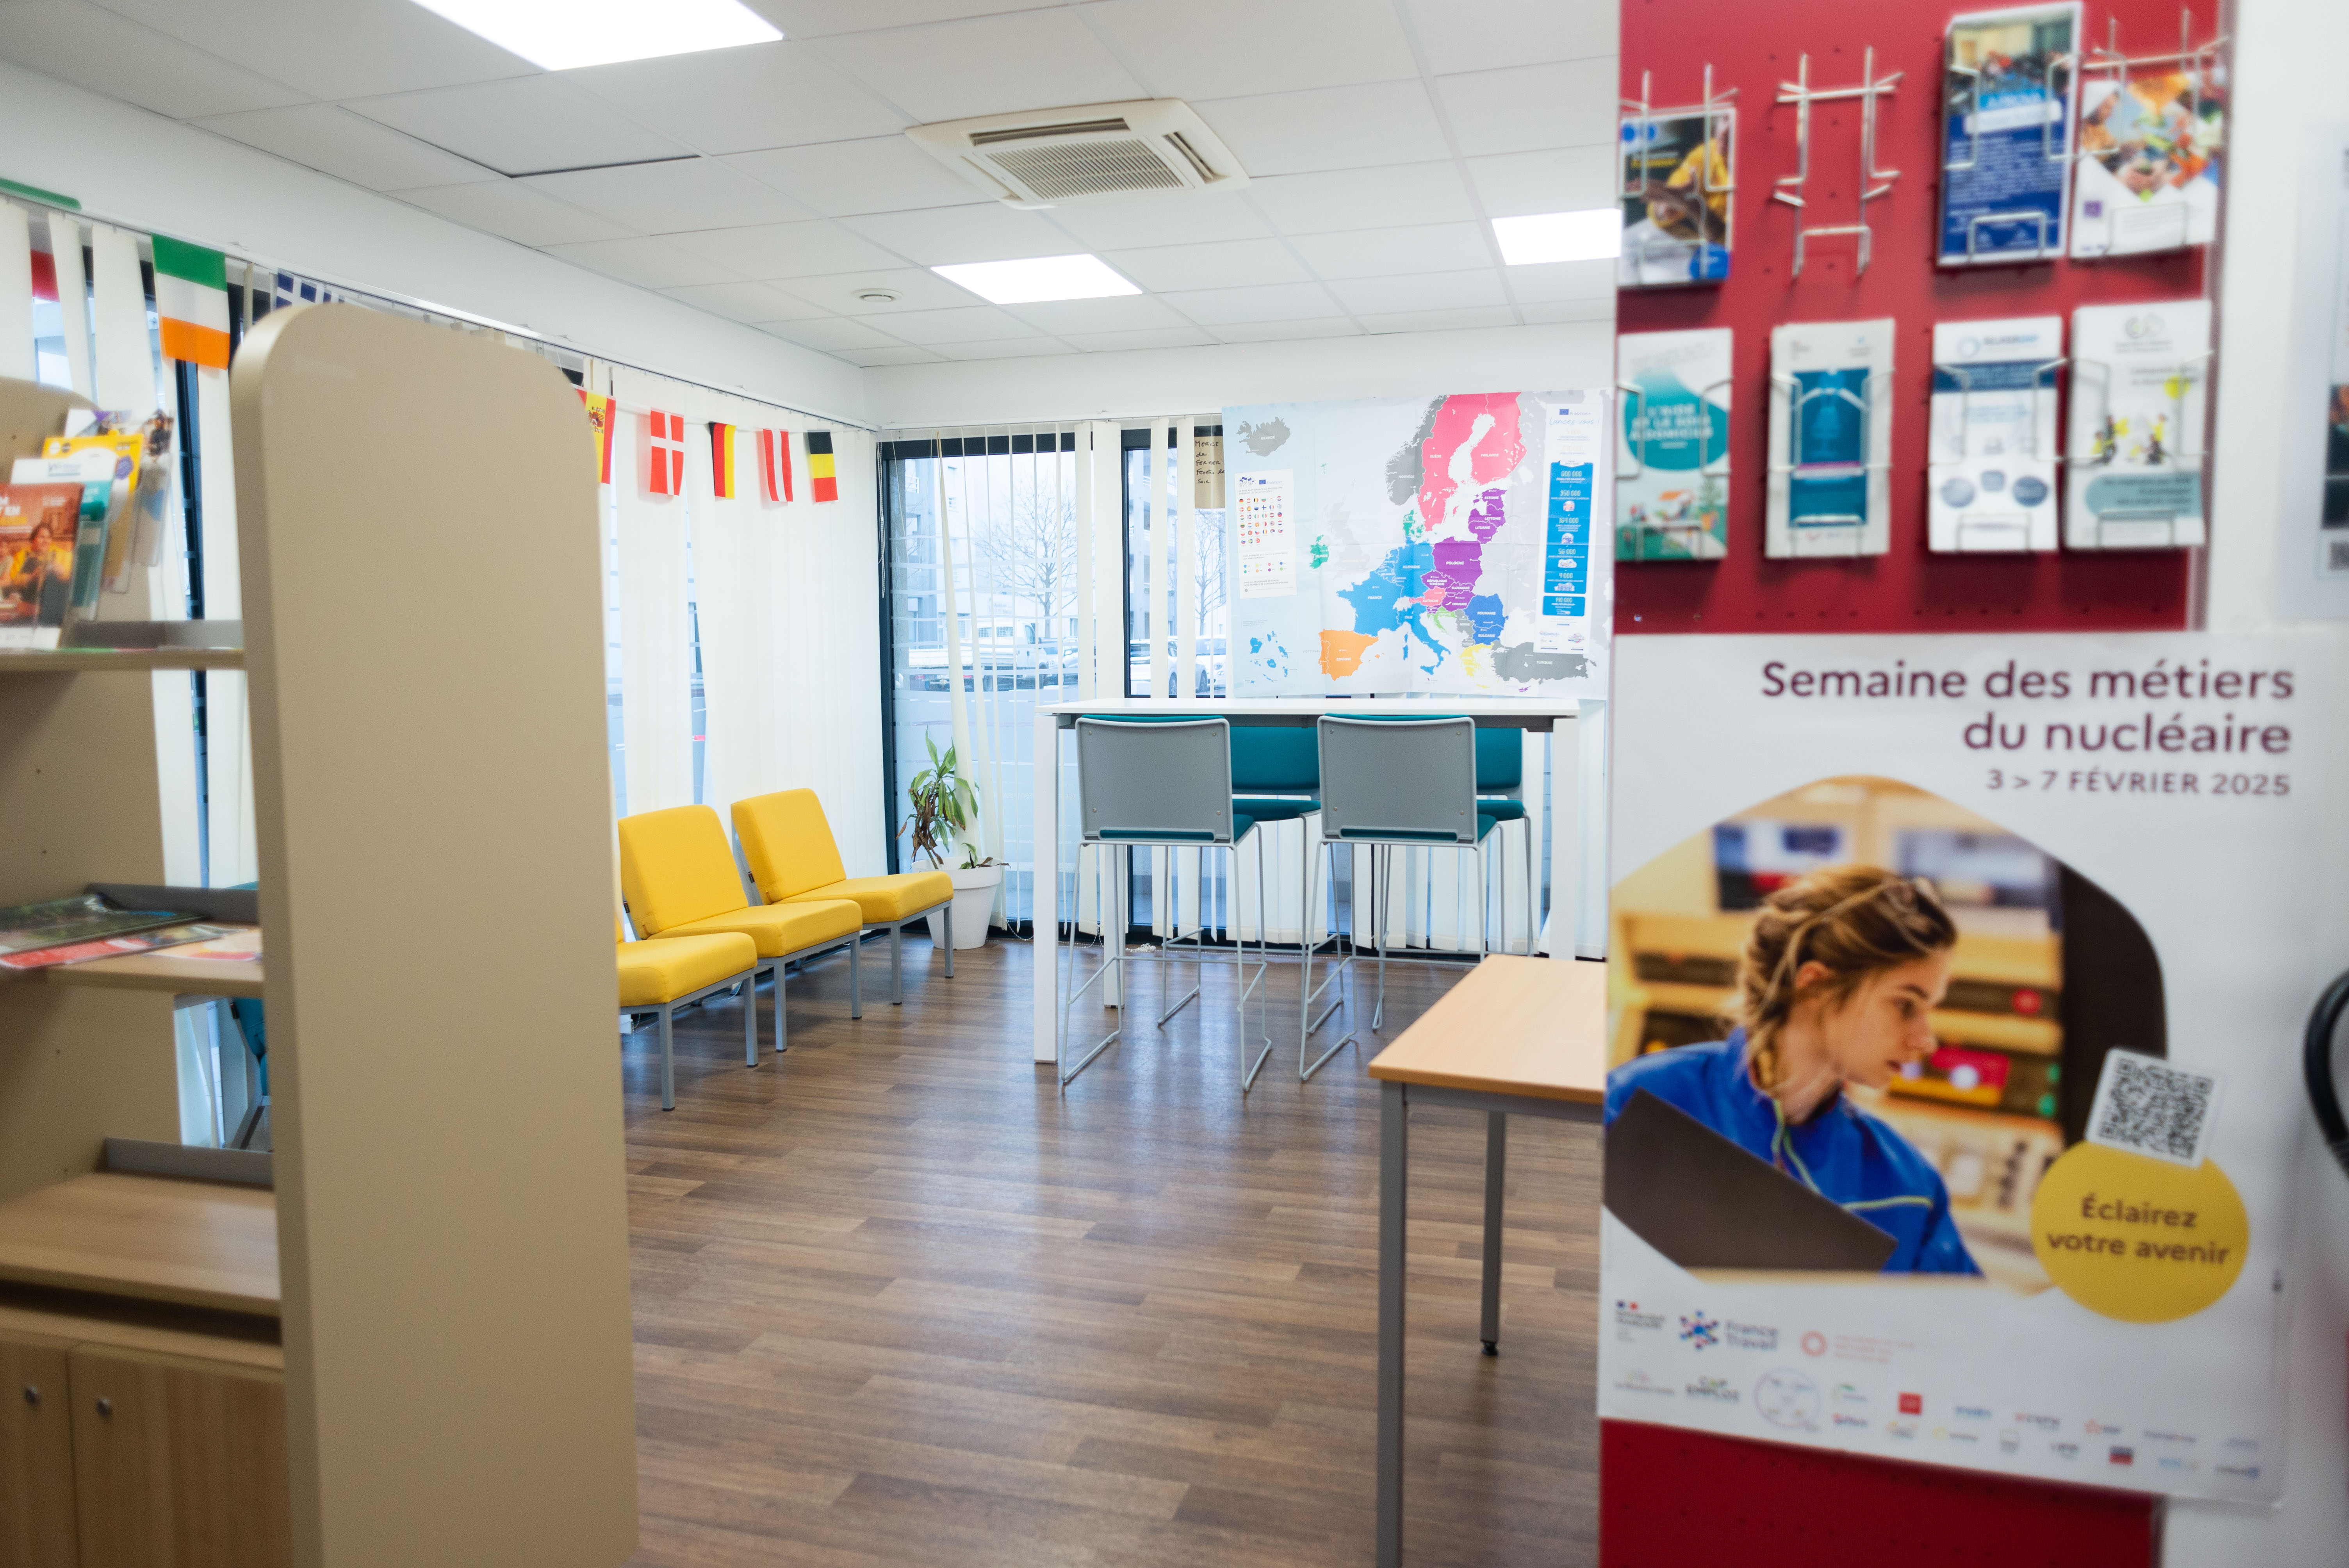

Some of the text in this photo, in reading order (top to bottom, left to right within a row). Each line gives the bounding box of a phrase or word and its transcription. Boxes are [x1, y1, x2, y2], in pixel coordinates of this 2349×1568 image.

[1761, 658, 2294, 699] Semaine des métiers
[1963, 711, 2291, 754] du nucléaire
[1986, 769, 2003, 790] 3
[2041, 770, 2058, 791] 7
[2069, 766, 2199, 793] FÉVRIER
[2212, 773, 2290, 796] 2025
[2081, 1192, 2197, 1228] Éclairez
[2046, 1233, 2229, 1265] votre avenir
